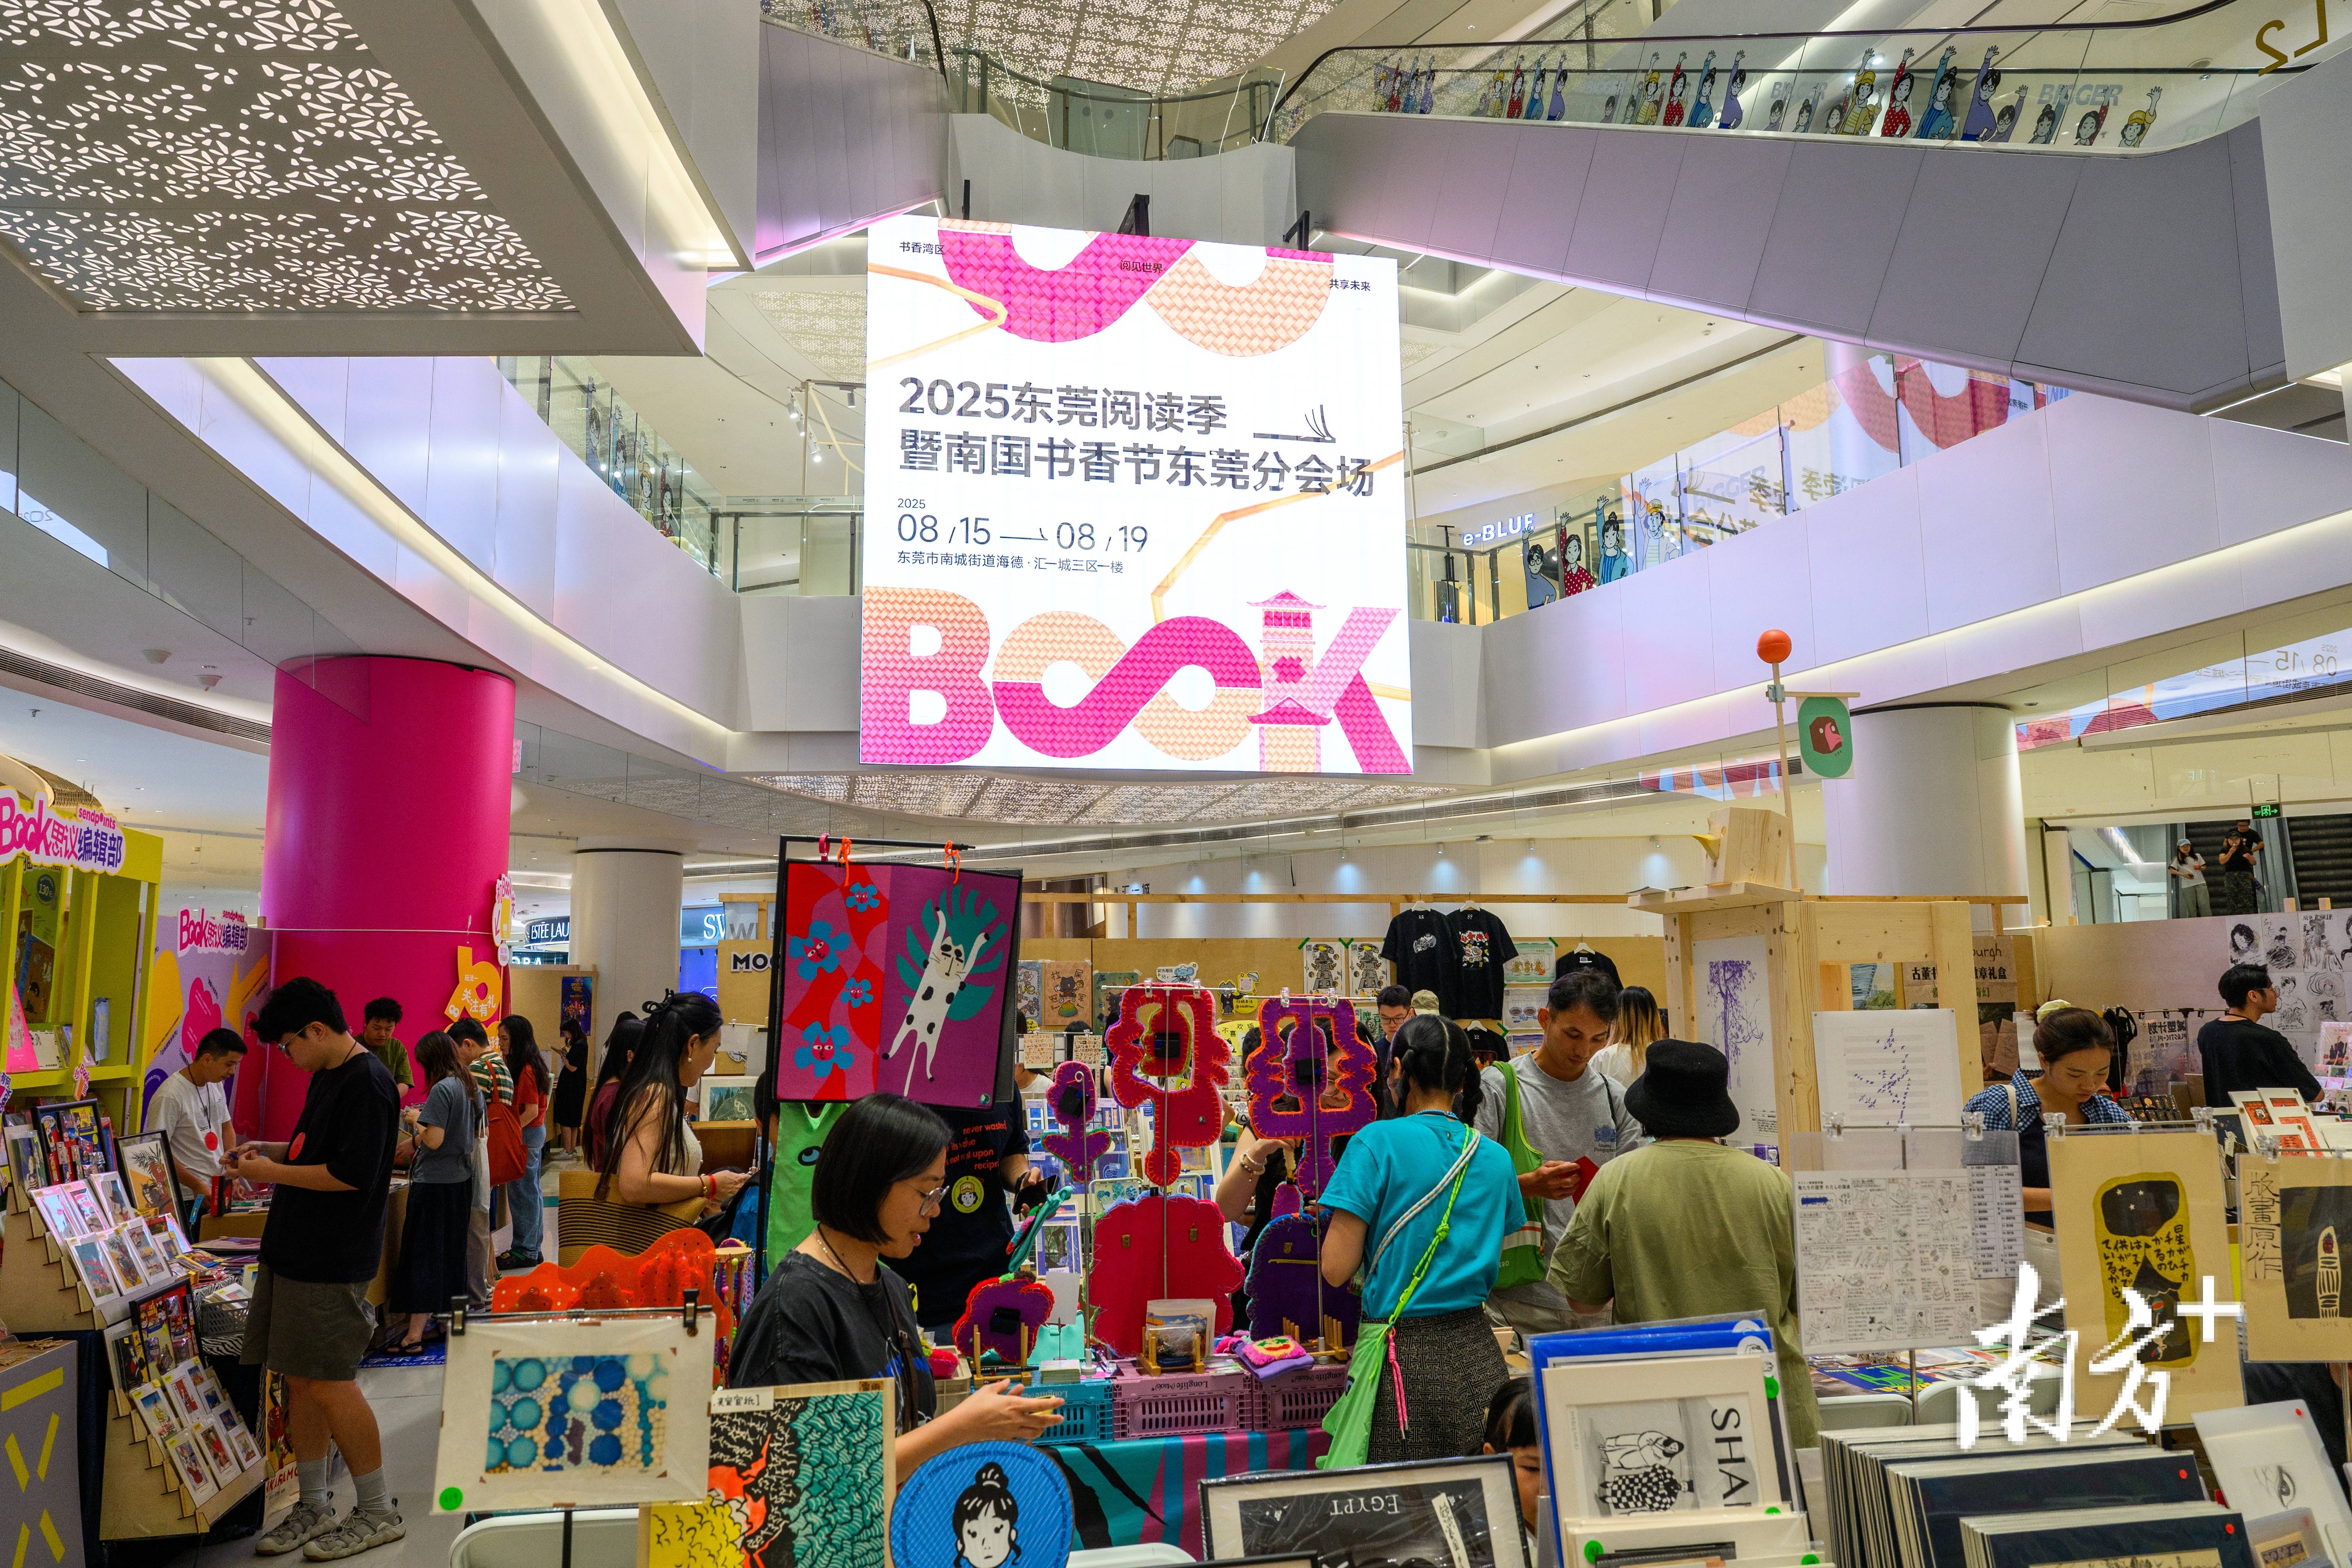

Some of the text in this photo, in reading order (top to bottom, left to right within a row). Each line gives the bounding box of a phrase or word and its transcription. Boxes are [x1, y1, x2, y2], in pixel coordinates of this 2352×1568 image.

[899, 241, 945, 255] 书香湾区
[1120, 259, 1163, 274] 阅见世界
[1329, 278, 1371, 292] 共享未来
[899, 377, 1228, 435] 2025东莞阅读季
[899, 428, 1374, 497] 暨南国书香节东莞分会场
[897, 498, 926, 509] 2025
[461, 988, 496, 1017] 关注有礼
[963, 1125, 982, 1135] never
[973, 1149, 994, 1160] upon
[1177, 1381, 1208, 1390] Longlife
[966, 1450, 992, 1461] BIGGER
[1711, 1408, 1752, 1507] SHA
[1330, 1494, 1400, 1516] EGYPT
